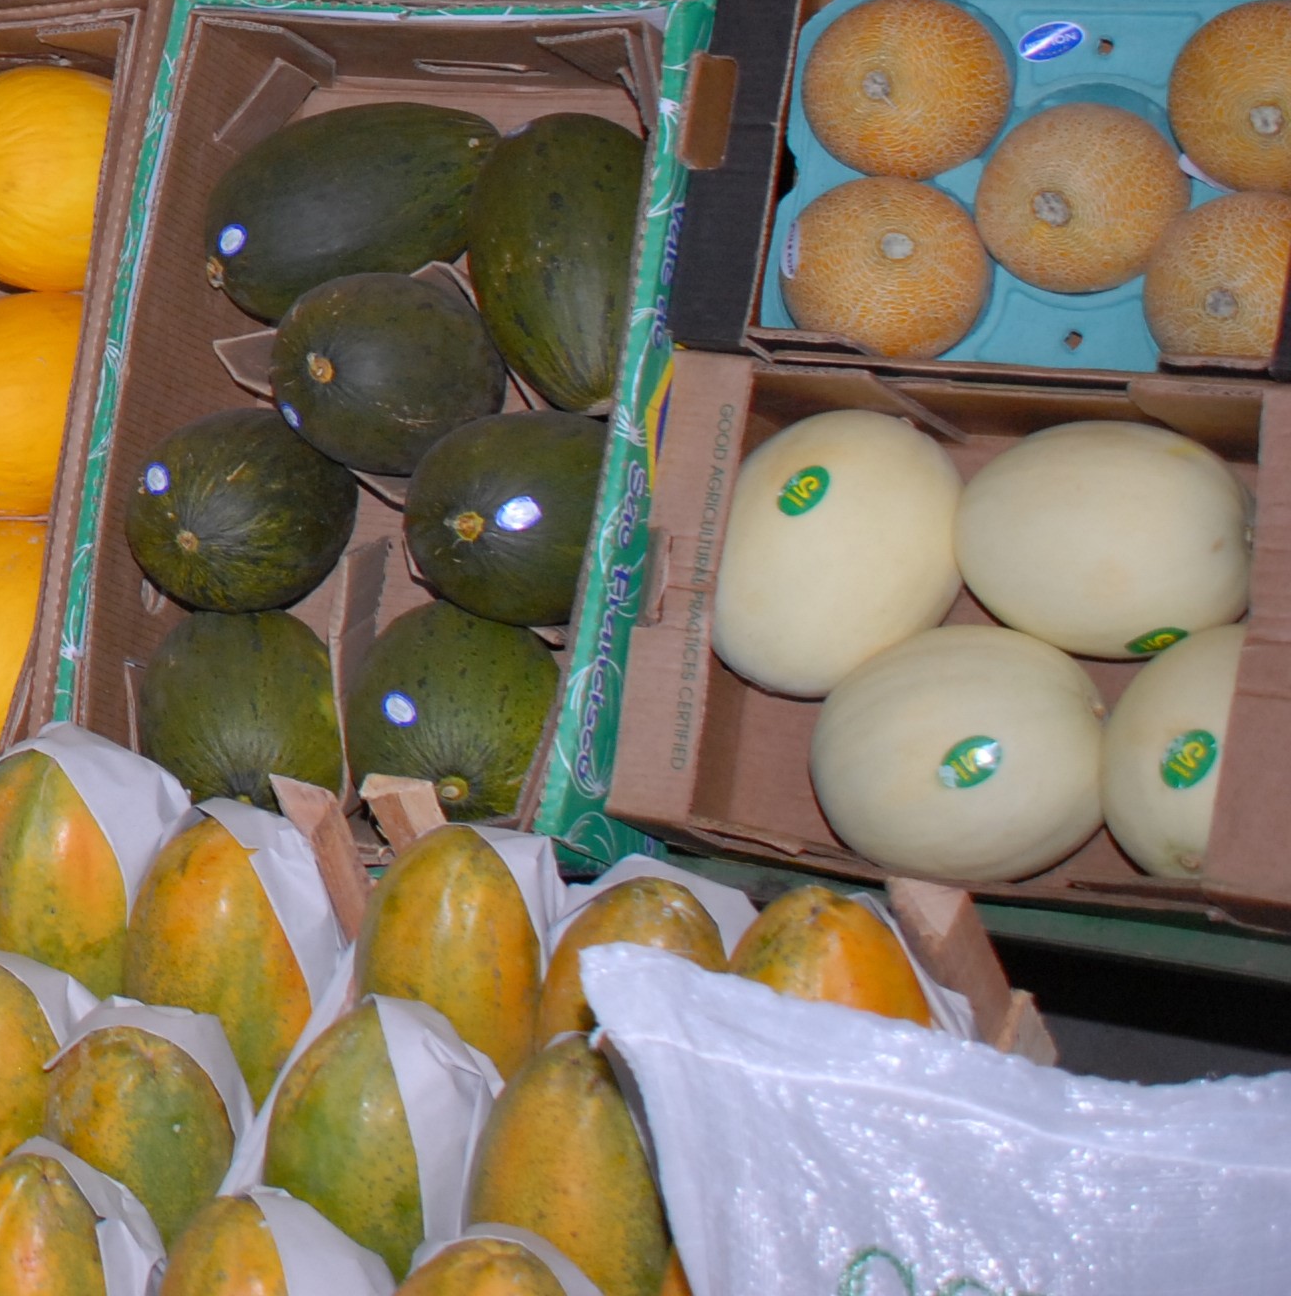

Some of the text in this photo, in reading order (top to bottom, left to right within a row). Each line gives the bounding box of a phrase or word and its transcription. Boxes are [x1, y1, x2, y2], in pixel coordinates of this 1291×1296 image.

[670, 403, 734, 772] GOOD AGRICULTURAL PRACTICES CERTIFIED
